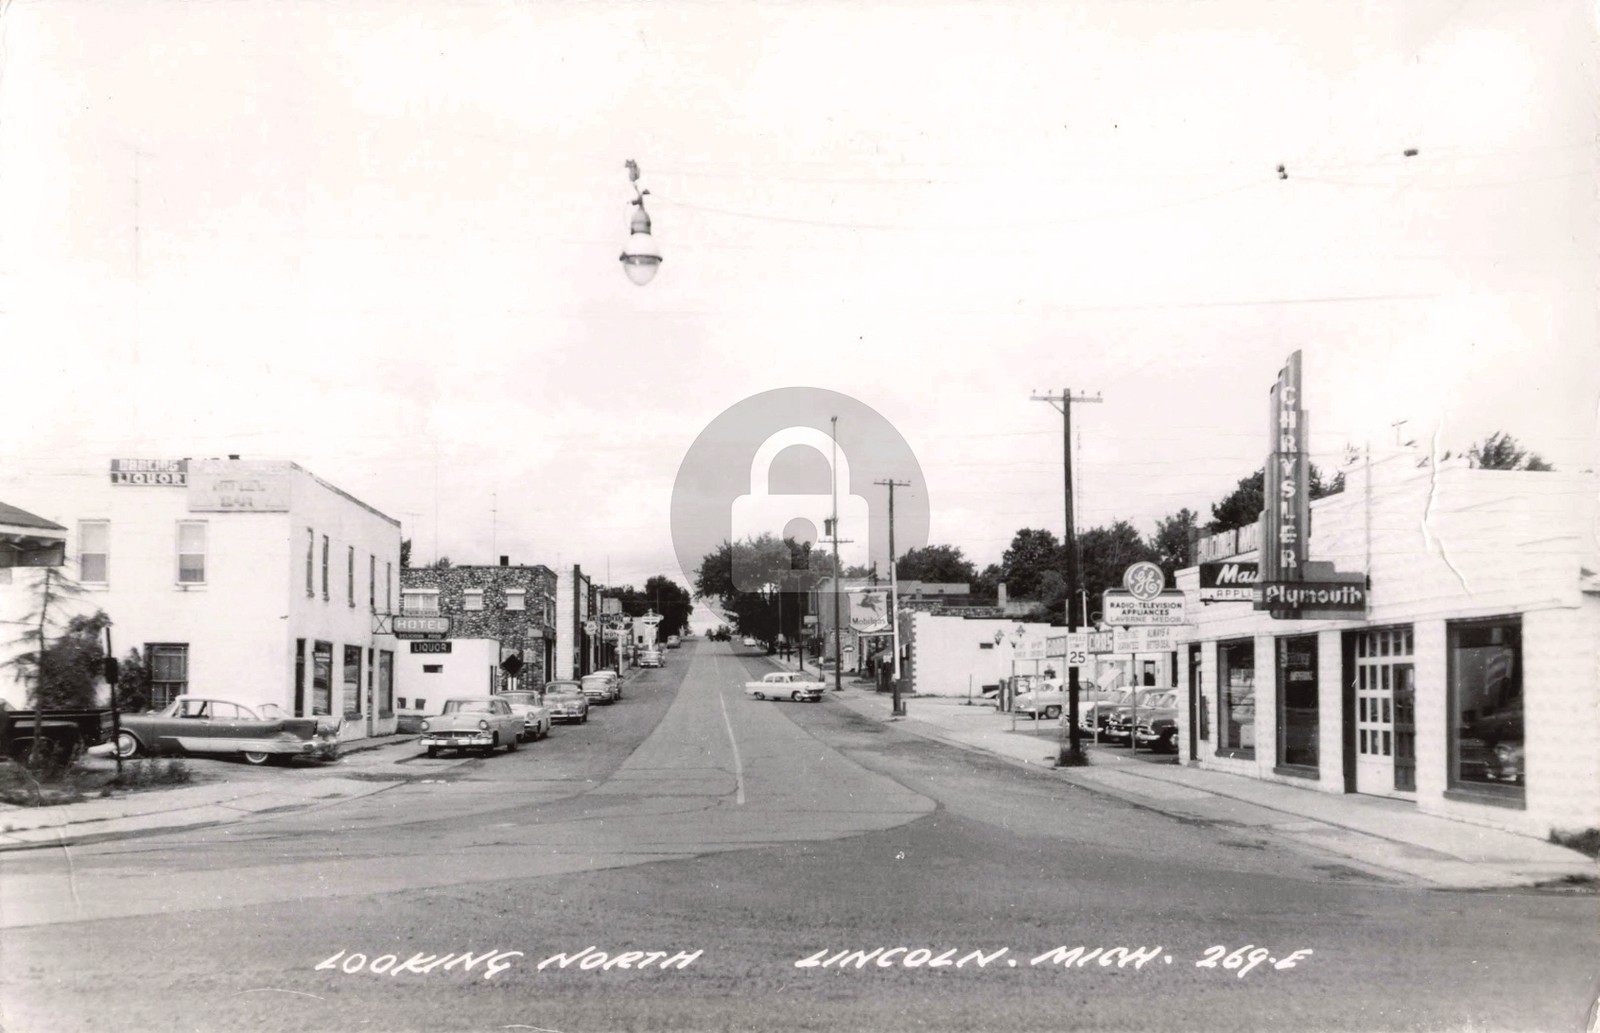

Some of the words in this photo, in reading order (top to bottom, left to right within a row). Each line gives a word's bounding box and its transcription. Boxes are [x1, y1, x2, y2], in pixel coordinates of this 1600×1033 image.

[118, 473, 184, 484] LIQUOR
[1280, 386, 1298, 569] CHRYSLER
[1266, 584, 1363, 609] Plymouth
[397, 619, 446, 629] HOTEL
[852, 617, 887, 627] Mobilgas
[413, 643, 448, 652] LIQUOR
[1069, 651, 1086, 664] 25
